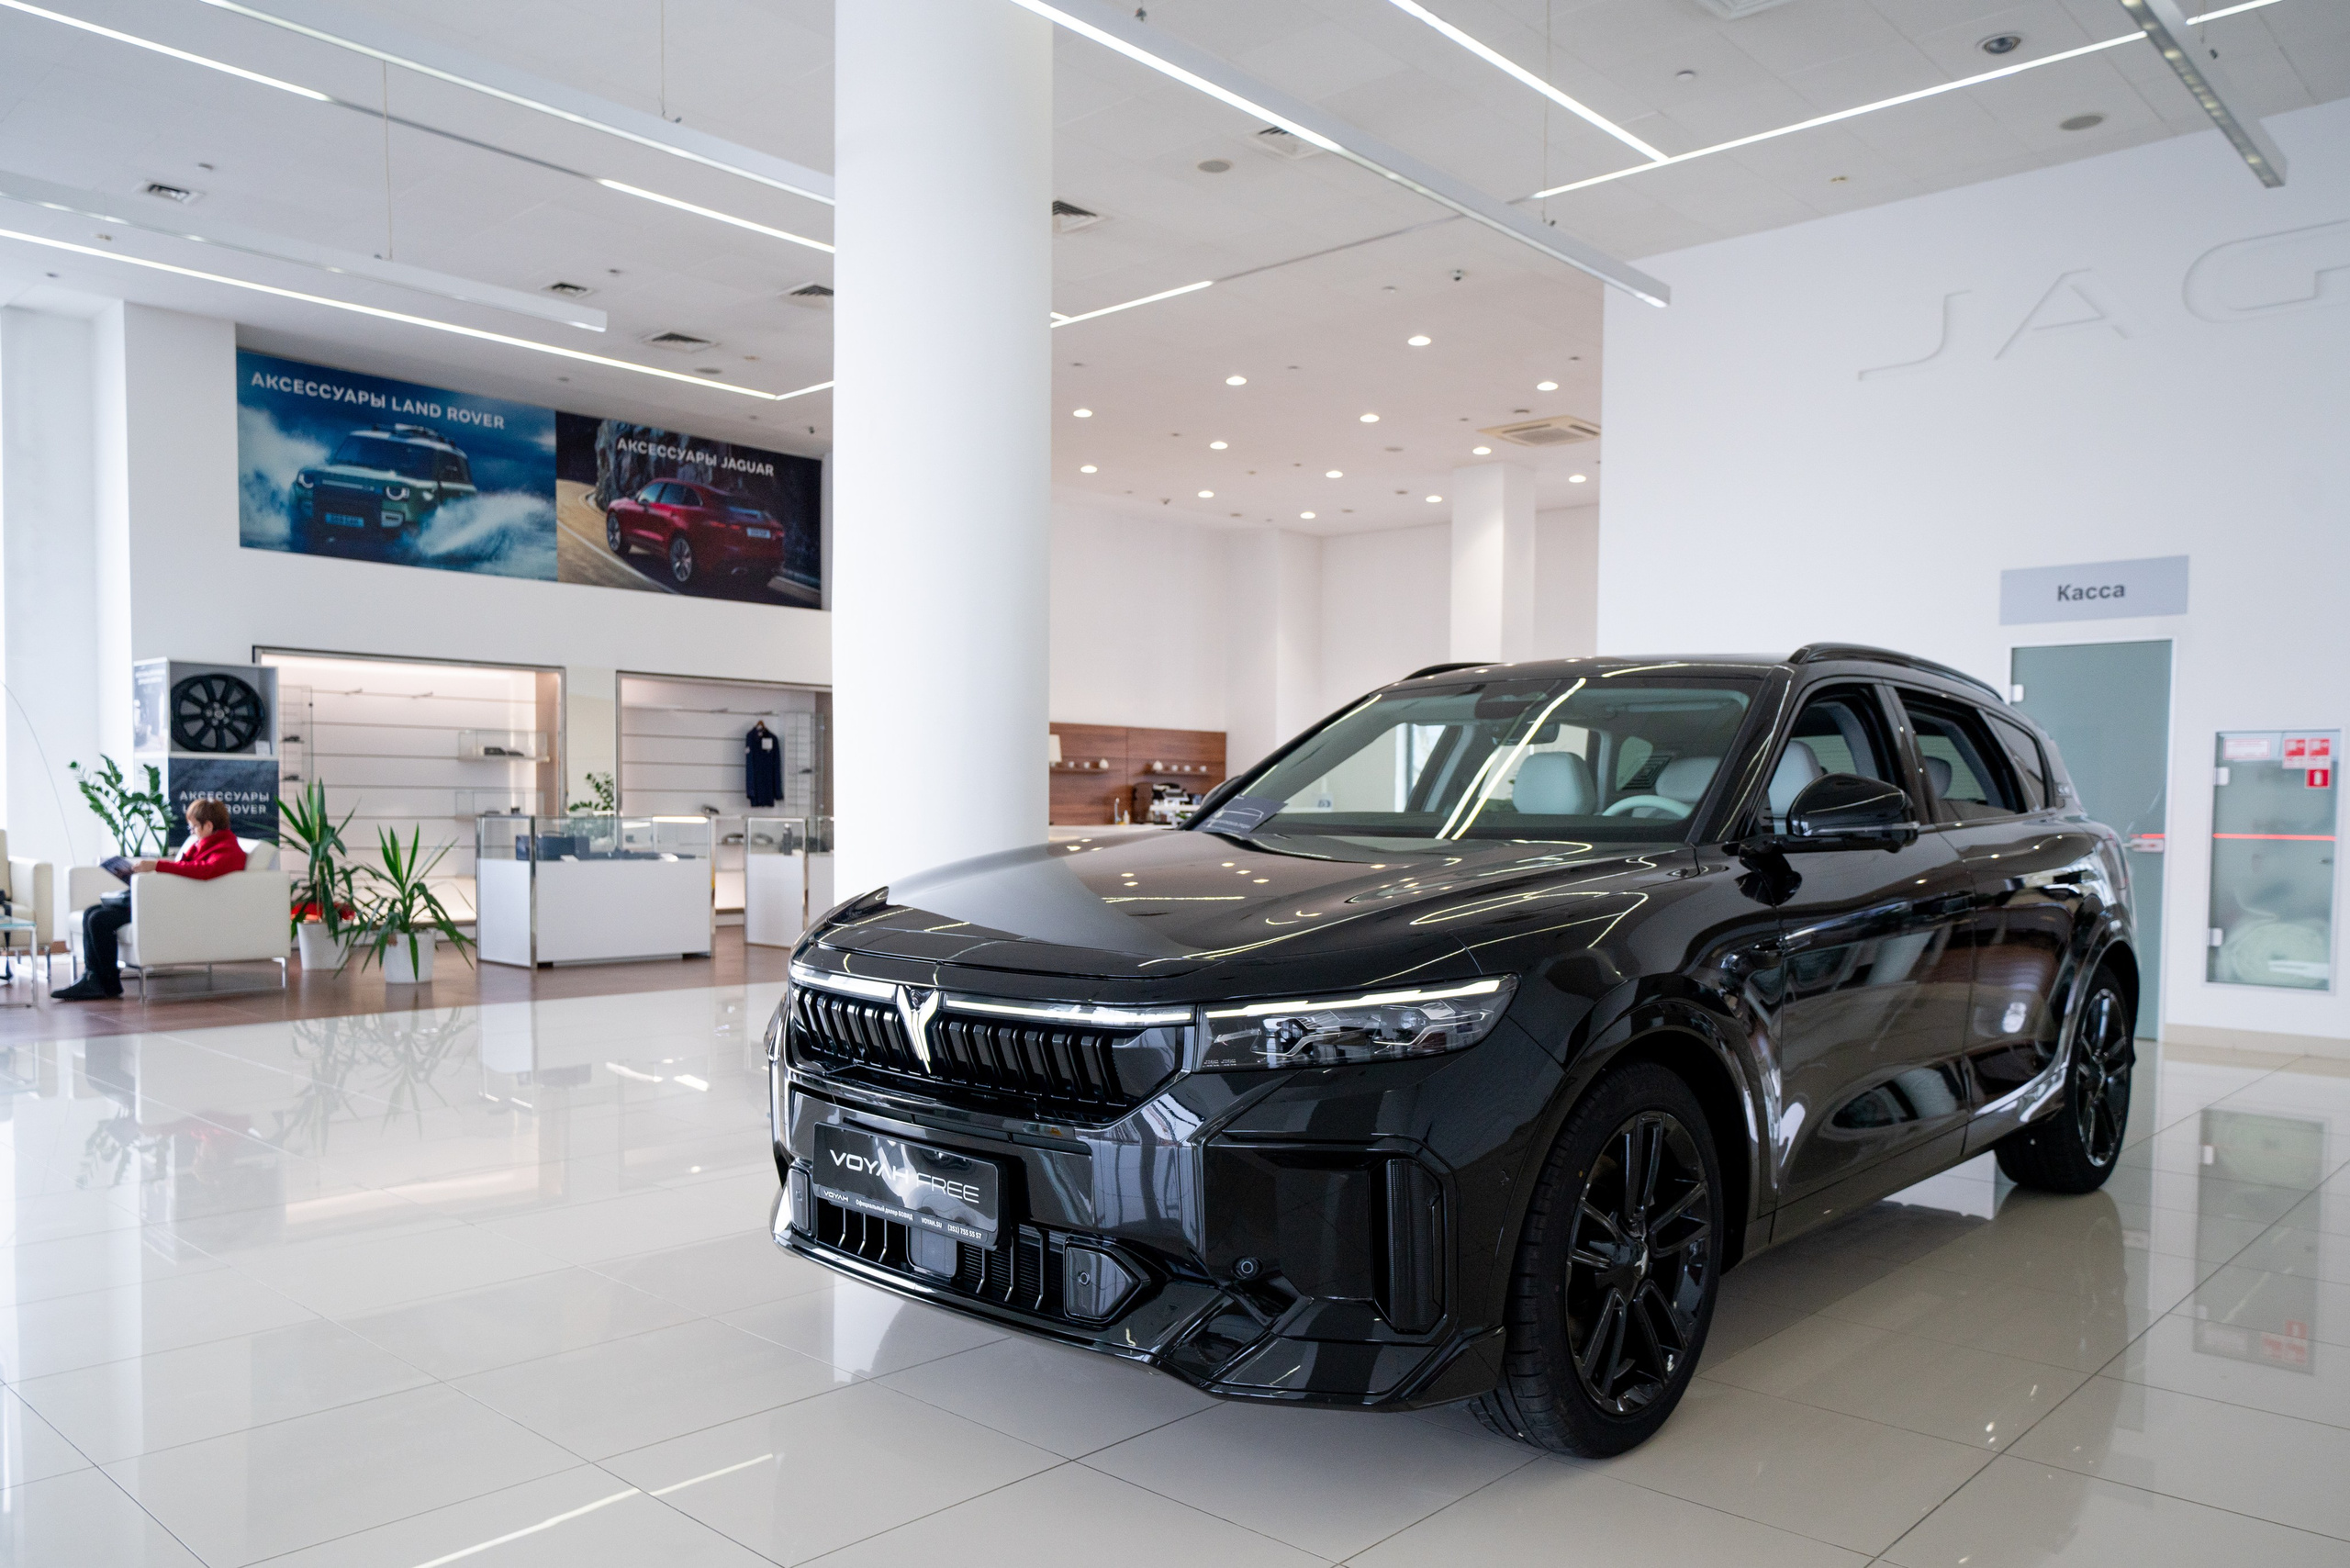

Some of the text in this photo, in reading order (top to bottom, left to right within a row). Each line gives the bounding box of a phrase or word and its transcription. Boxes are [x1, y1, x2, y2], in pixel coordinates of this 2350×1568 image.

[251, 371, 506, 430] АКСЕССУАРЫ LAND ROVER
[617, 437, 775, 477] АКСЕССУАРЫ JAGUAR
[2056, 583, 2126, 601] Касса
[179, 790, 270, 802] АКСЕССУАРЫ
[829, 1149, 979, 1204] VOYAH FREE
[823, 1190, 850, 1203] VOYAH
[856, 1199, 885, 1212] Официальный
[884, 1206, 899, 1216] дилер
[921, 1216, 943, 1228] VOYAH.SU
[947, 1224, 960, 1235] (351)
